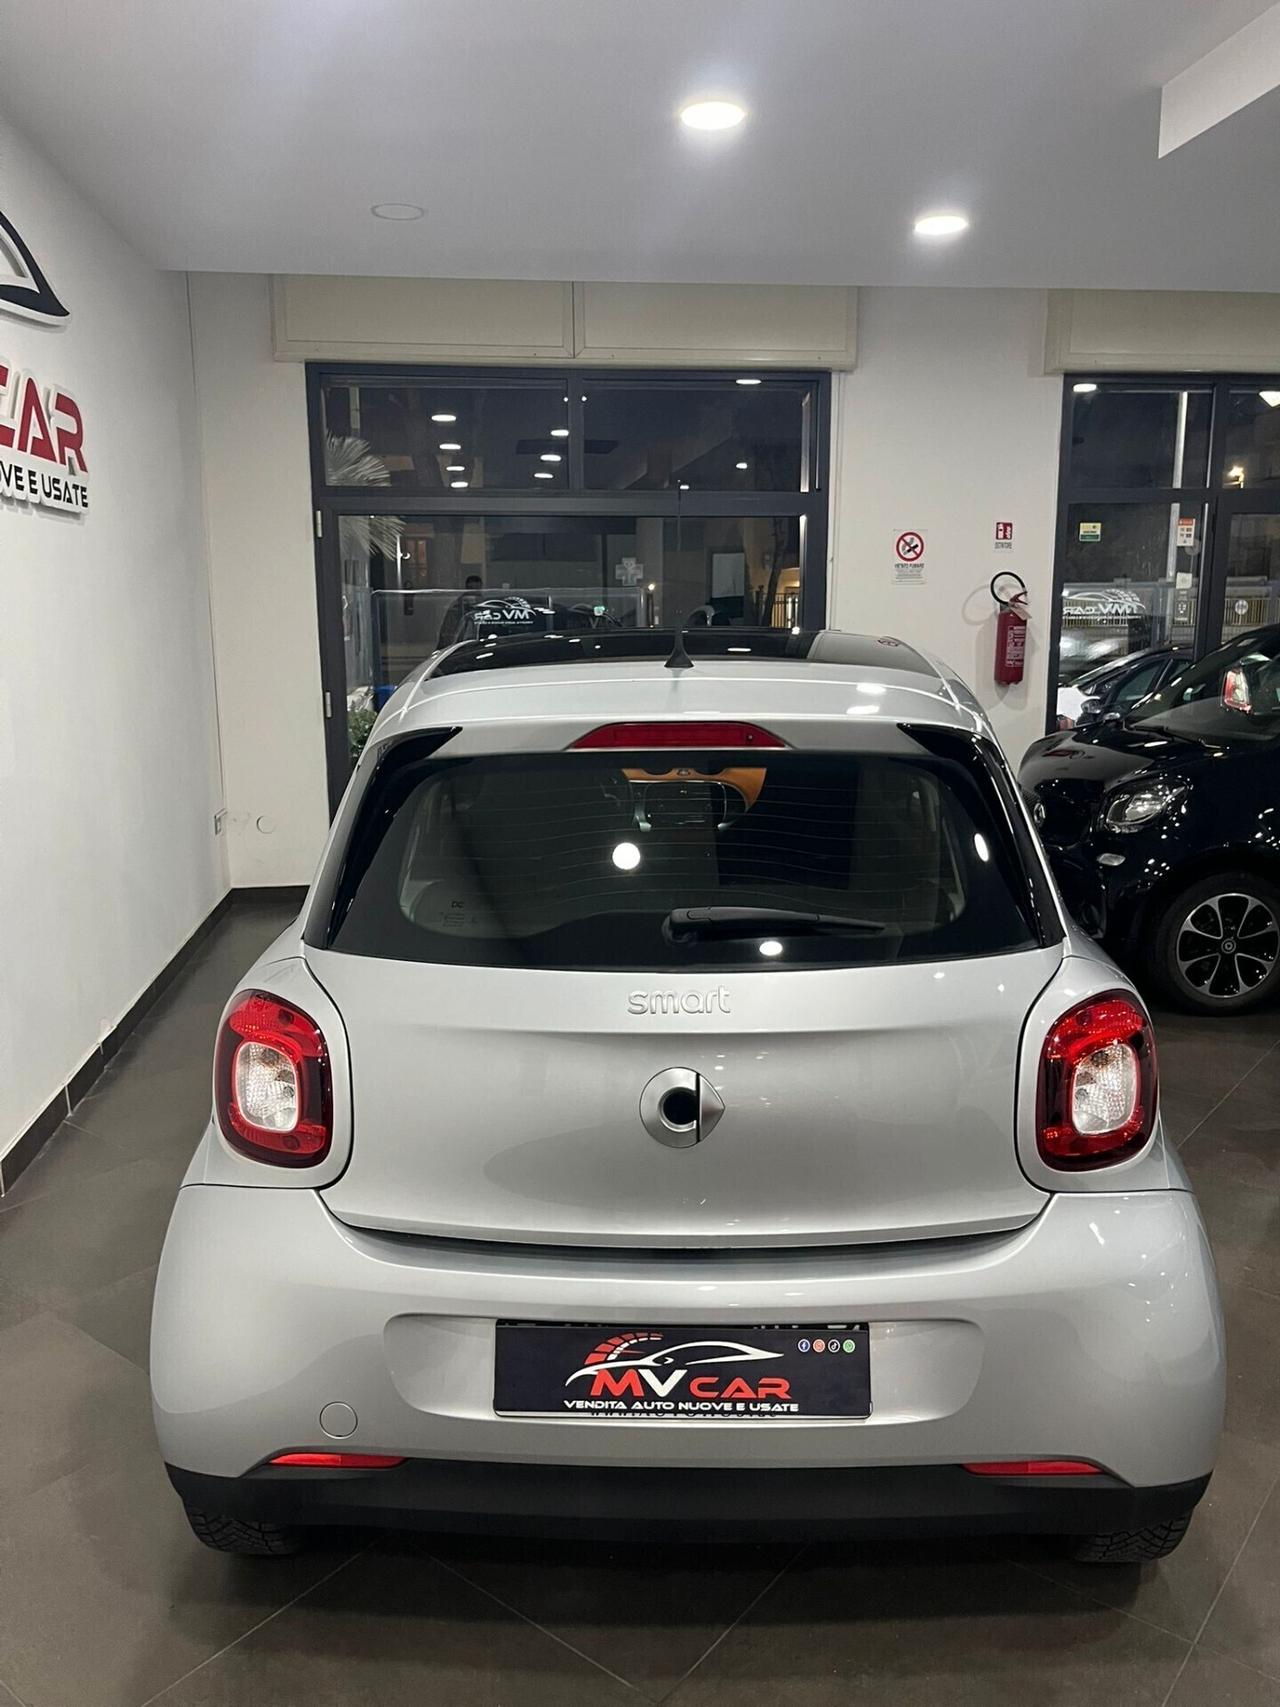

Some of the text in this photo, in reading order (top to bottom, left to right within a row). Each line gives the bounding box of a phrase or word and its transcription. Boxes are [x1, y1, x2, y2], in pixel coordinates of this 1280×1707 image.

[0, 459, 88, 508] VE E USATE
[627, 985, 731, 1015] smart
[590, 1369, 792, 1399] MV CAR
[563, 1400, 799, 1412] VENDITA AUTO NUOVE E USATE
